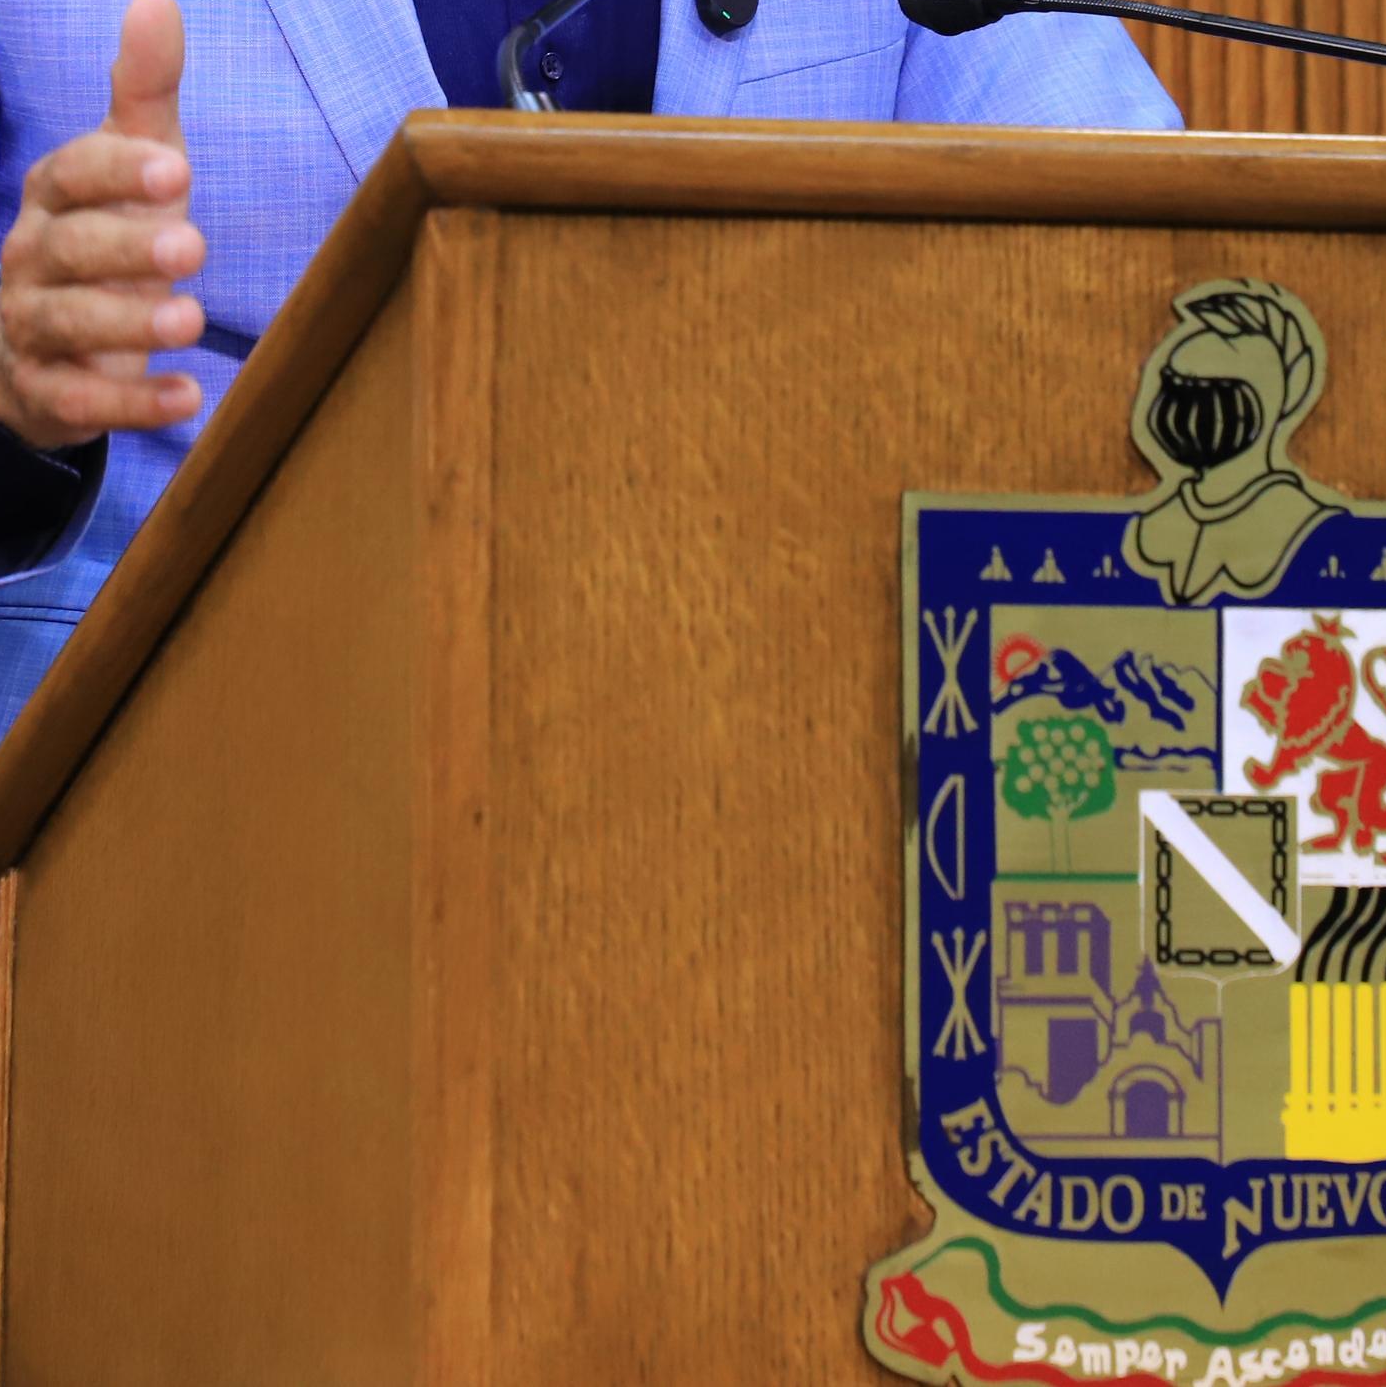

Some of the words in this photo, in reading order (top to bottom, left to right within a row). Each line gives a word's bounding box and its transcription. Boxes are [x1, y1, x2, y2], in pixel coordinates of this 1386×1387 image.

[940, 1097, 1145, 1233] ESTADO
[1160, 1183, 1207, 1221] DE
[1013, 1321, 1188, 1379] Semper
